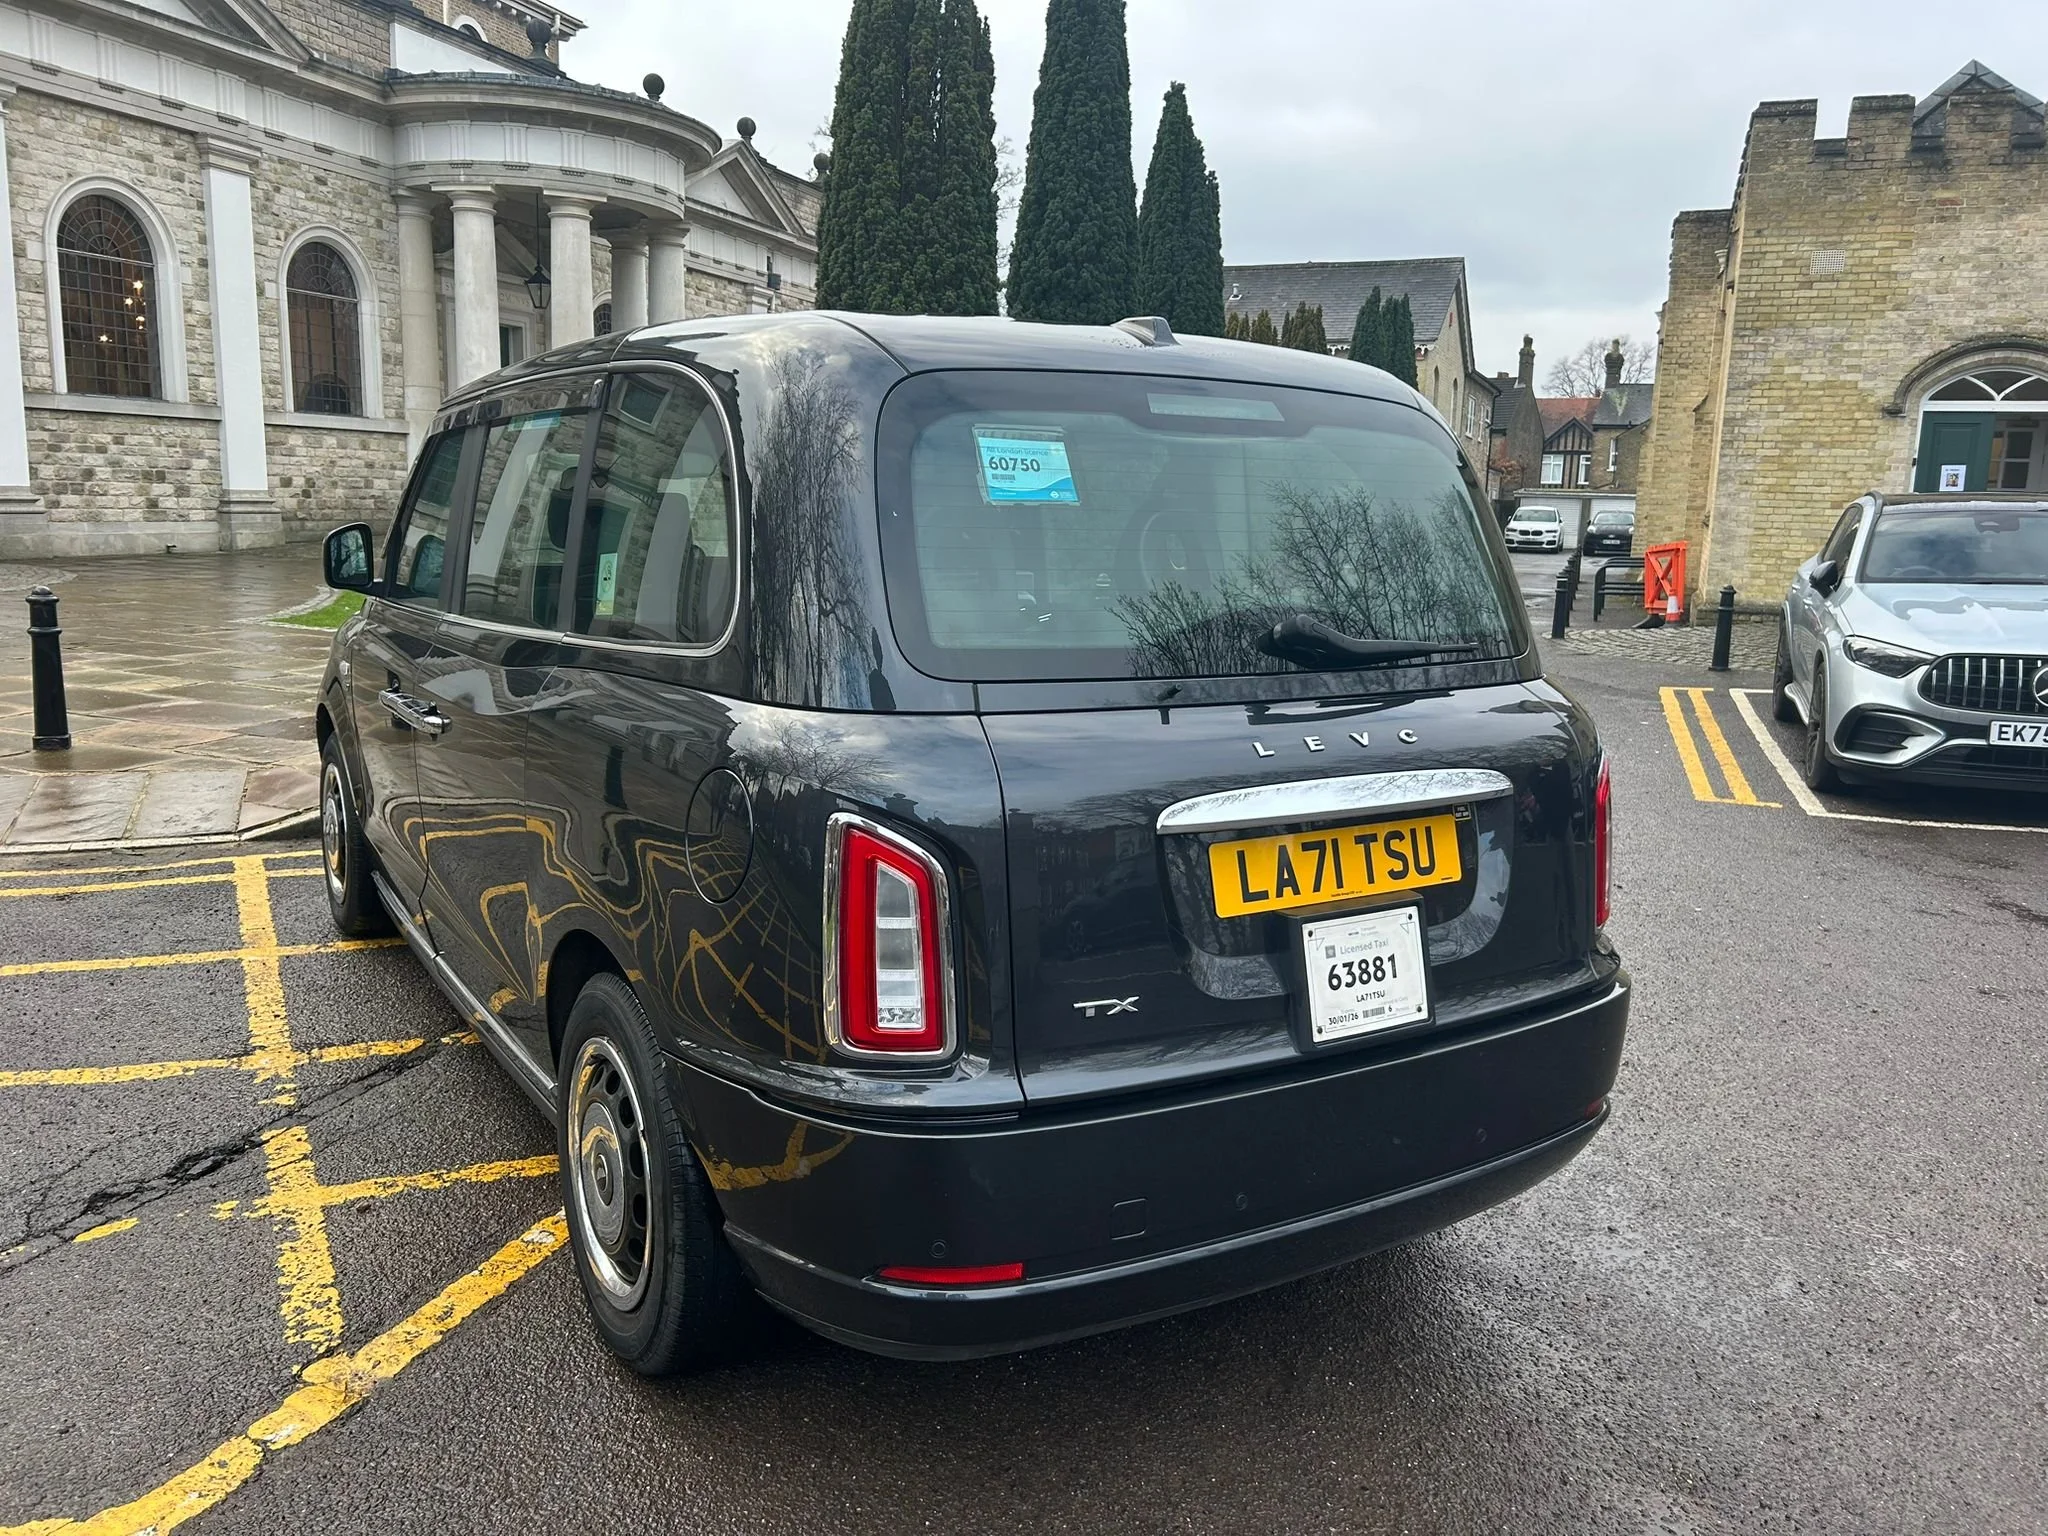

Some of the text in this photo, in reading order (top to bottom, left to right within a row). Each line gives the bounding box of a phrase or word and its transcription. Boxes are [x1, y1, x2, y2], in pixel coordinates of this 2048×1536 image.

[988, 456, 1041, 473] 60750
[1252, 728, 1418, 758] LEVC
[1236, 825, 1436, 904] LA71 TSU
[1340, 938, 1389, 955] Licensed Taxi
[1327, 953, 1398, 991] 63881
[1355, 990, 1386, 1003] LA71TSU
[1073, 996, 1140, 1018] TX
[1328, 1013, 1359, 1026] 30/01/26
